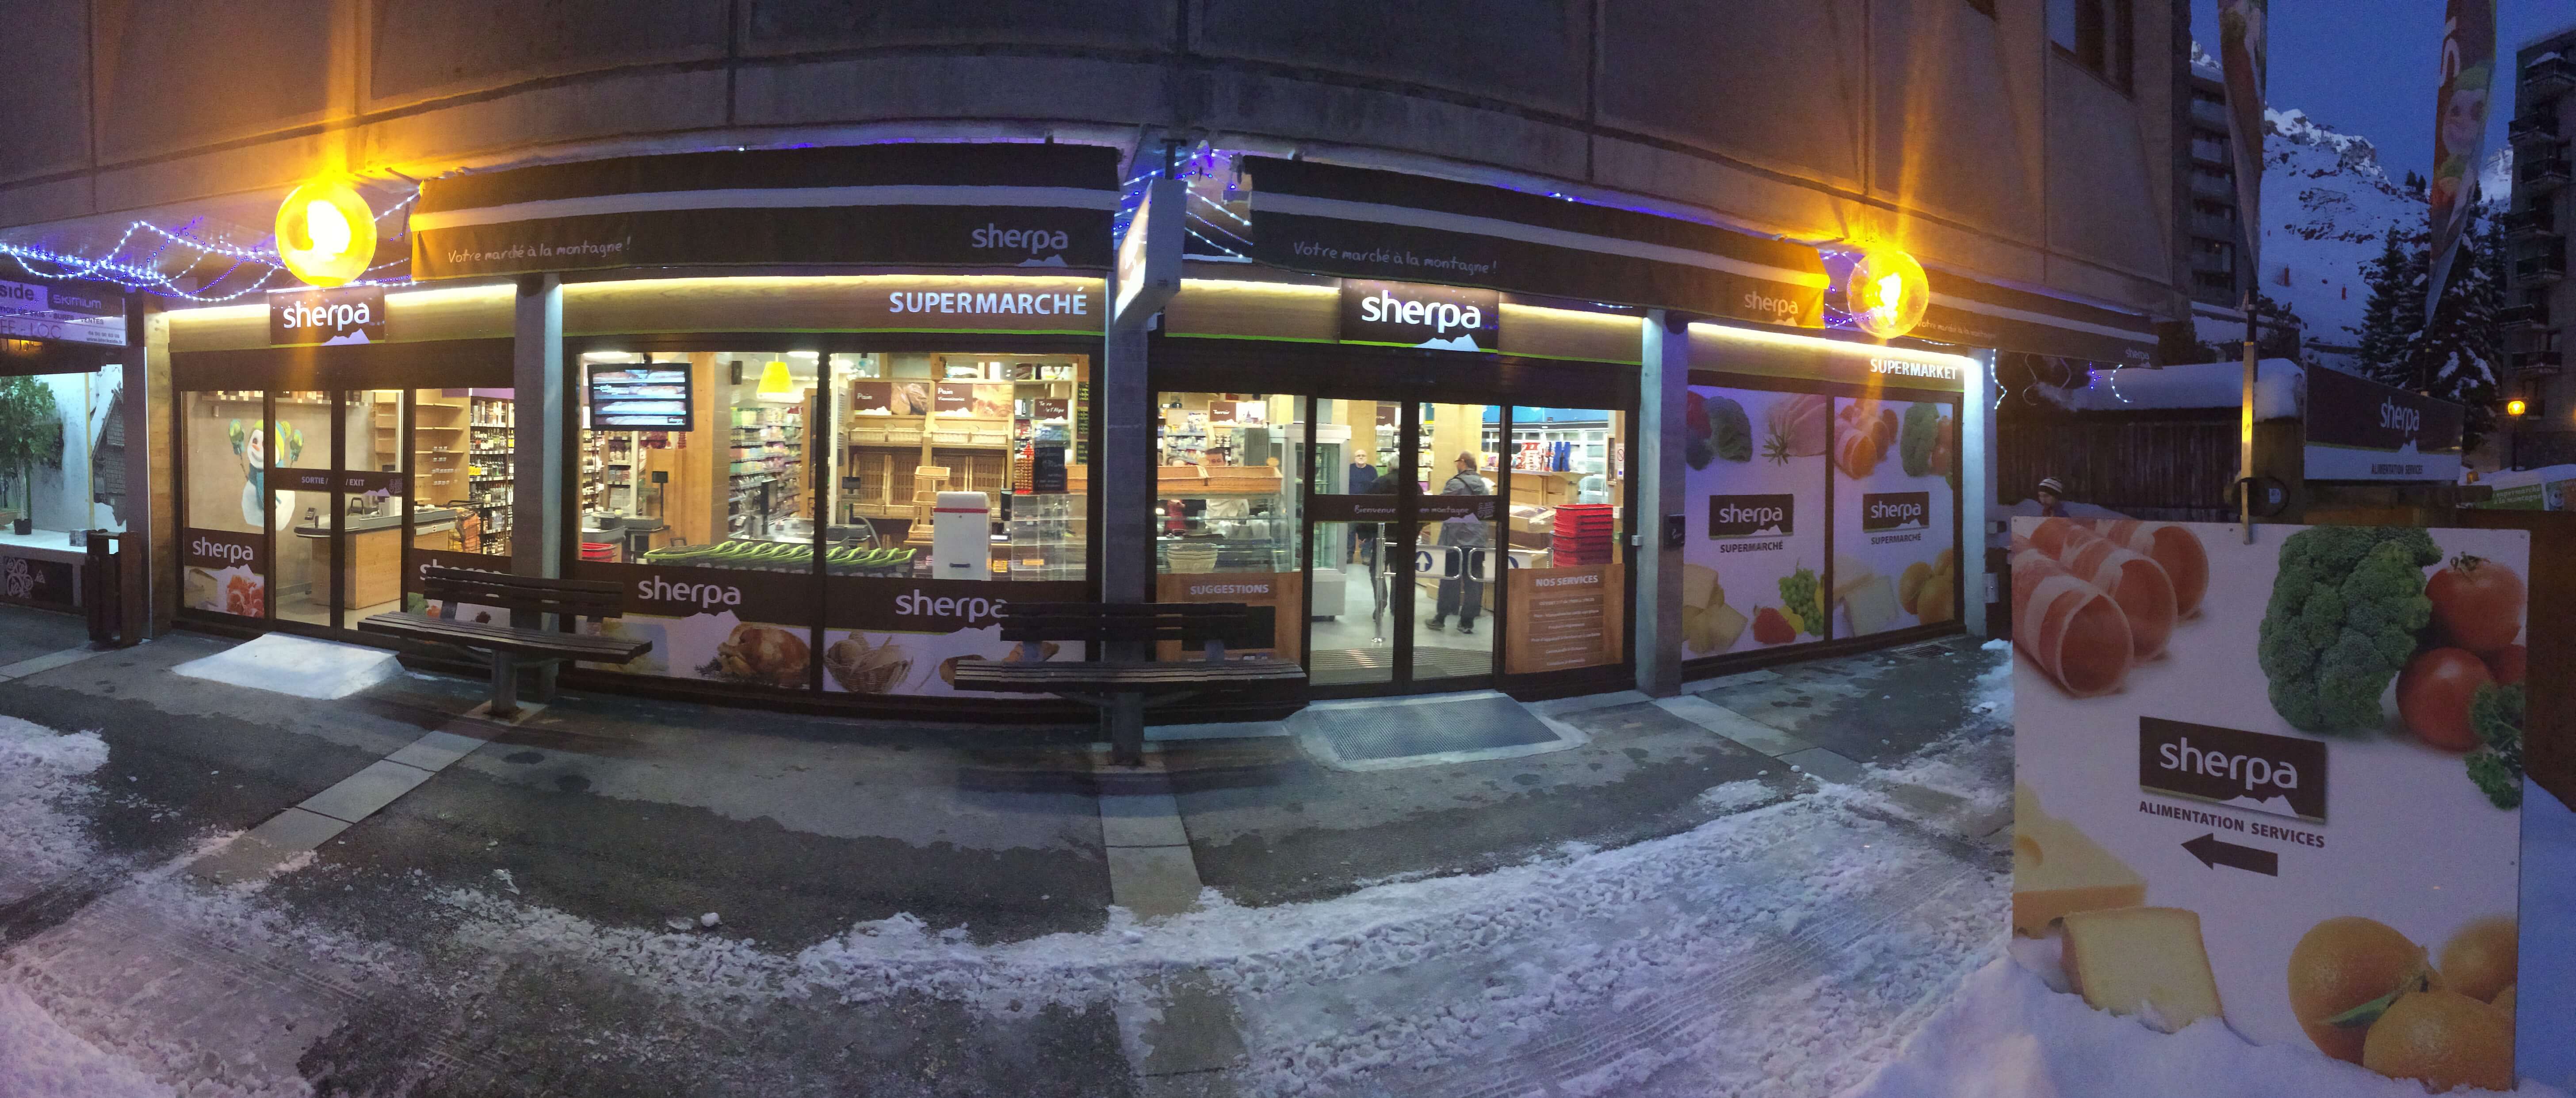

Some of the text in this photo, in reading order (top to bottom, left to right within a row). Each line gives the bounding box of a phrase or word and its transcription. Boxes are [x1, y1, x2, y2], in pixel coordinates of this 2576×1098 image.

[972, 223, 1068, 254] sherpa
[448, 250, 480, 263] Votre
[485, 244, 524, 260] marché
[527, 246, 536, 257] à
[539, 243, 552, 257] la
[556, 240, 623, 258] montagne
[1293, 241, 1338, 259] Votre
[1342, 248, 1390, 263] marché
[1393, 252, 1403, 264] à
[1406, 251, 1420, 266] la
[1423, 256, 1489, 276] montagne
[889, 287, 1087, 315] SUPERMARCHÉ
[1361, 290, 1481, 333] sherpa
[1744, 290, 1799, 315] sherpa
[283, 301, 370, 332] sherpa
[1870, 358, 1957, 380] SUPERMARKET
[2380, 396, 2419, 438] sherpa
[302, 476, 325, 484] SORTIE
[2371, 463, 2423, 475] ALIMENTATION SERVICES
[1354, 504, 1396, 514] Bienvenue
[1719, 503, 1783, 526] sherpa
[1870, 500, 1922, 520] sherpa
[192, 537, 254, 564] sherpa
[1720, 540, 1784, 553] SUPERMARCHÉ
[1871, 533, 1922, 545] SUPERMARCHÉ
[638, 575, 742, 609] sherpa
[1190, 584, 1269, 595] SUGGESTIONS
[1536, 575, 1599, 587] NOS SERVICES
[2159, 737, 2298, 791] sherpa
[2139, 801, 2325, 849] ALIMENTATION SERVICES
